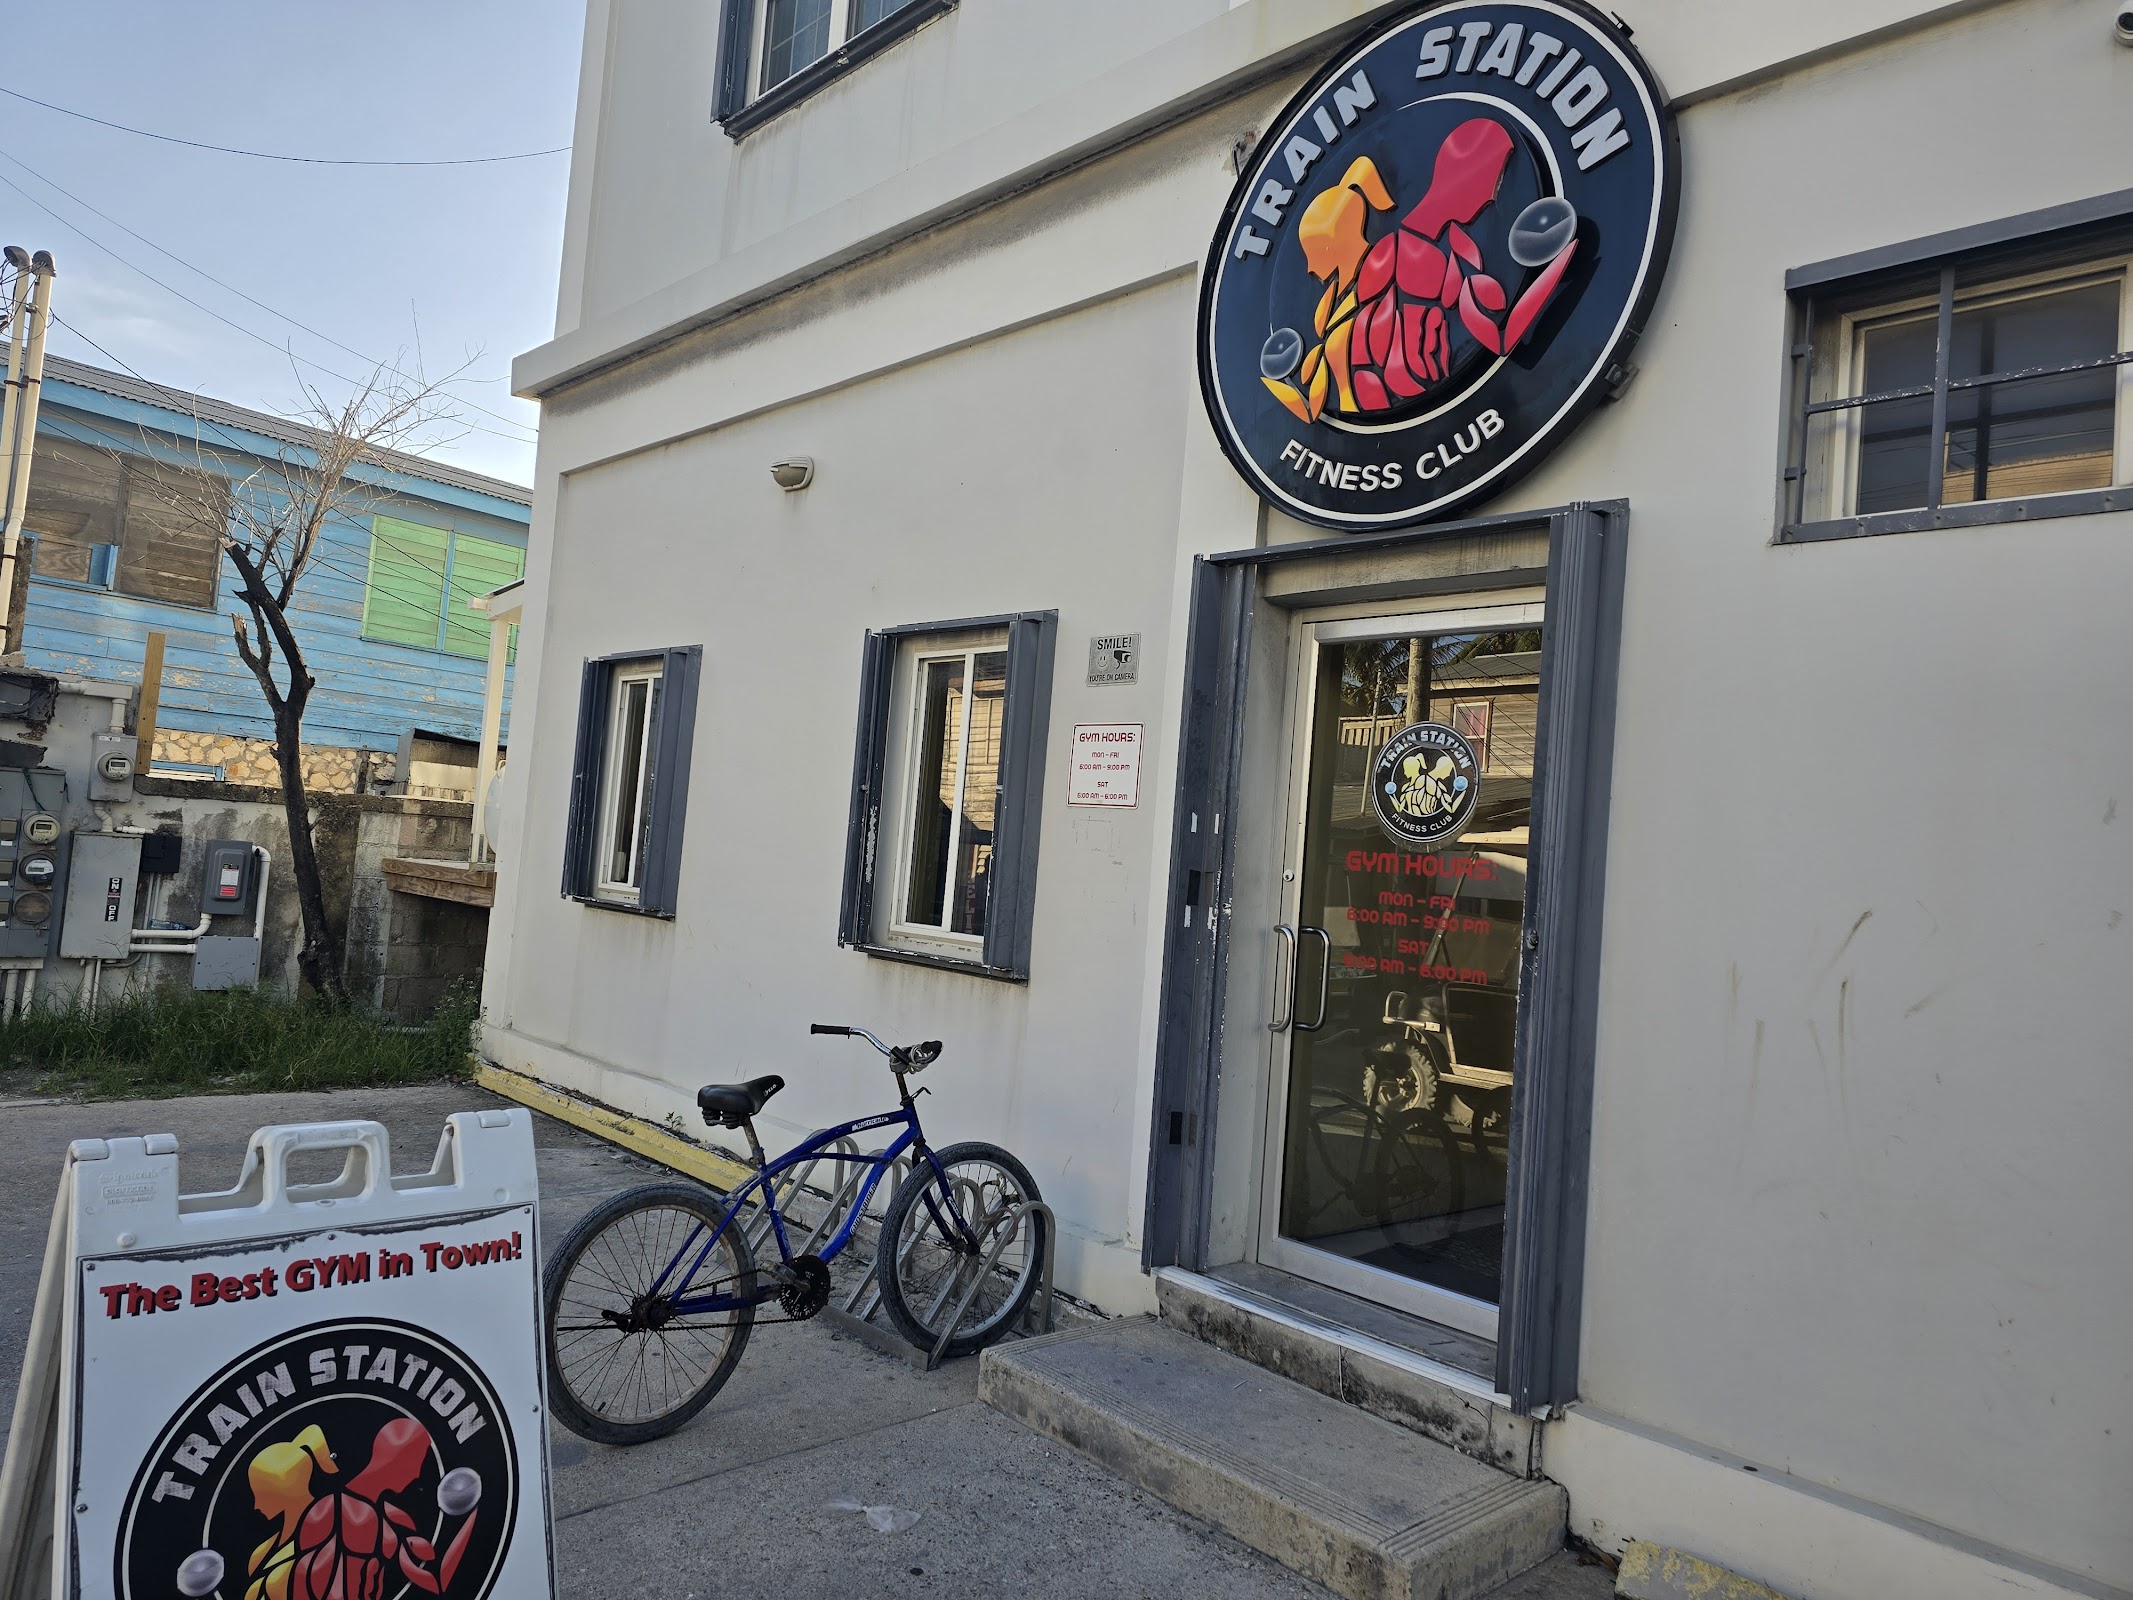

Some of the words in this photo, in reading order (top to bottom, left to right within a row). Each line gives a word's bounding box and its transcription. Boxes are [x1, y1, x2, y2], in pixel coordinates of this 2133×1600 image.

[1234, 69, 1379, 263] TRAIN
[1415, 21, 1633, 172] STATION
[1279, 438, 1403, 494] FITNESS
[1416, 408, 1506, 482] CLUB
[1097, 637, 1132, 650] SMILE!
[1106, 673, 1114, 681] ON
[1115, 672, 1135, 681] CAMERA
[1079, 733, 1100, 742] GYM
[1102, 733, 1136, 742] HOURS:
[1381, 732, 1417, 768] TRAIN
[1420, 730, 1472, 769] STATION
[1391, 813, 1428, 833] FITNESS
[1429, 814, 1453, 831] CLUB
[1346, 850, 1399, 875] GYM
[1405, 853, 1499, 881] HOURS:
[111, 878, 120, 890] ON
[1378, 891, 1414, 908] MON
[1429, 895, 1456, 911] FRI
[108, 905, 116, 921] OFF
[1382, 911, 1408, 926] AM
[1423, 914, 1460, 931] 9:00
[1462, 918, 1491, 935] PM
[1397, 938, 1430, 955] SAT
[1380, 958, 1405, 975] AM
[1419, 963, 1457, 981] 6:00
[1460, 967, 1489, 985] PM
[99, 1283, 181, 1320] The
[190, 1266, 278, 1307] Best
[284, 1251, 371, 1291] GYM
[378, 1247, 413, 1280] in
[418, 1230, 523, 1275] Town!
[151, 1361, 298, 1504] TRAIN
[308, 1344, 488, 1445] STATION
